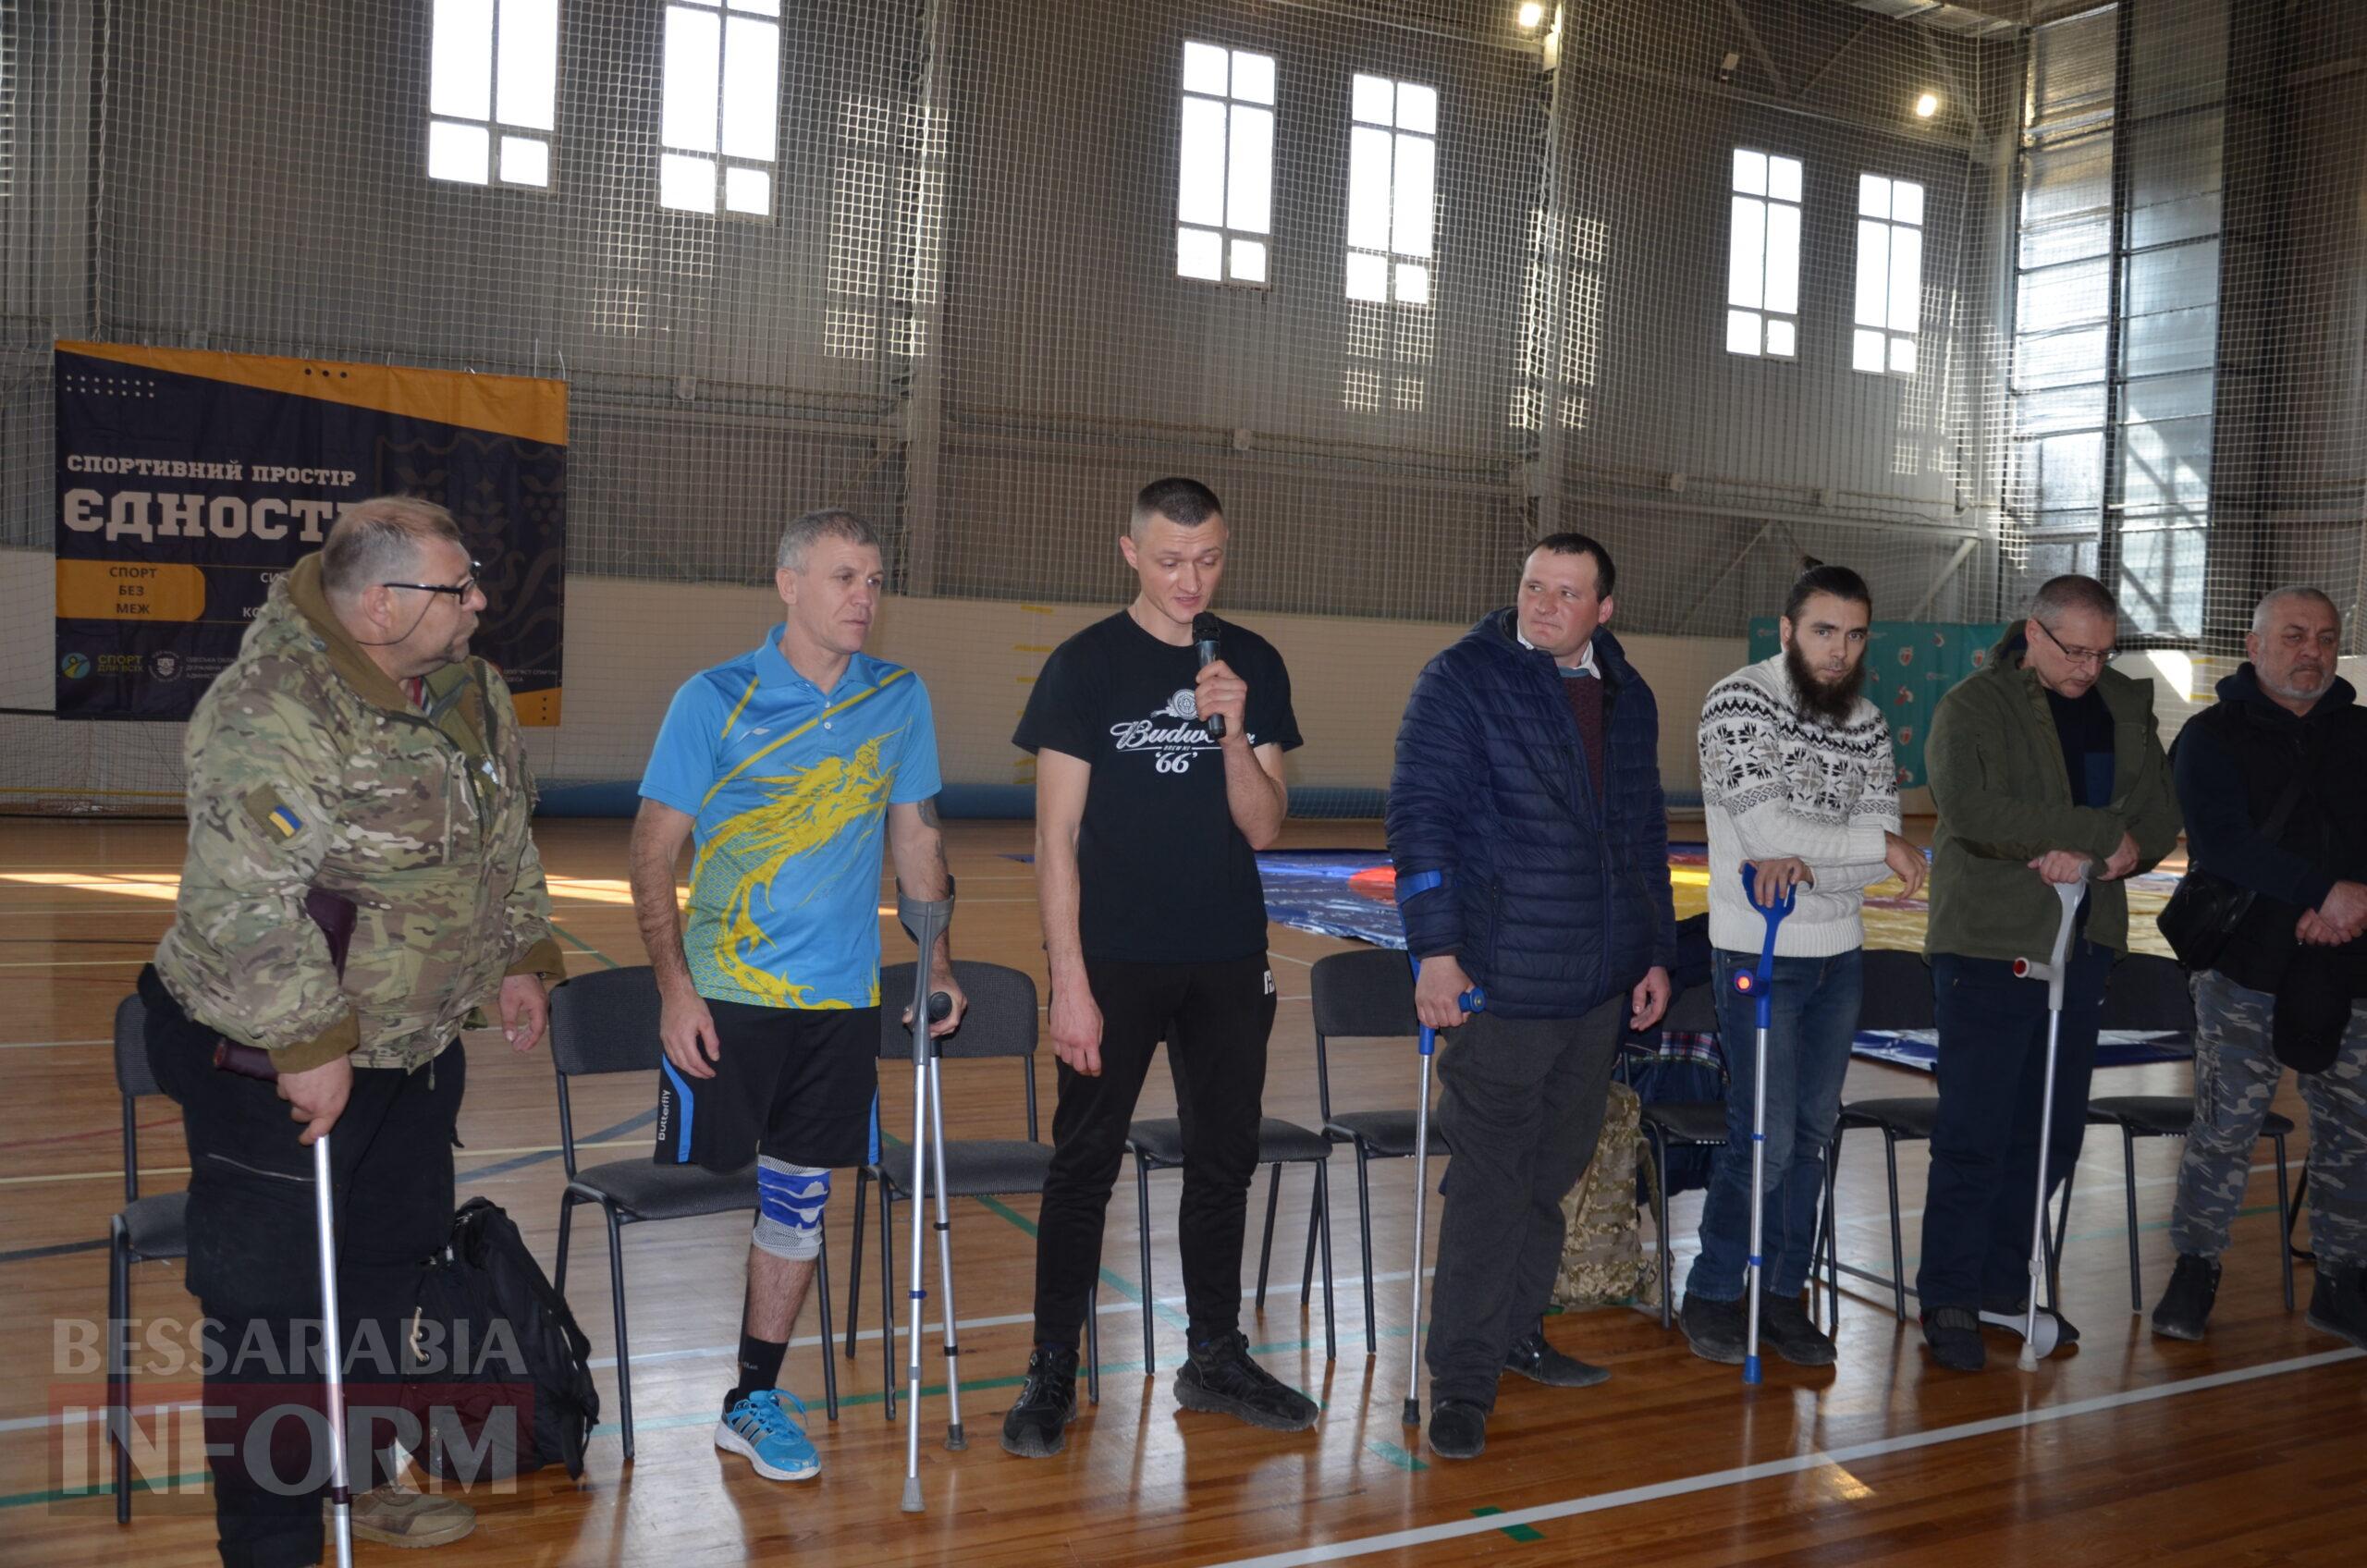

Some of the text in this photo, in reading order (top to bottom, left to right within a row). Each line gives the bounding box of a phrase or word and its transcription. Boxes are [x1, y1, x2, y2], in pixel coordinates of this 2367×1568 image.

[67, 454, 357, 486] СПОРТИВНИЙ ПРОСТІР
[109, 566, 157, 579] СПОРТ
[118, 585, 144, 596] БЕЗ
[116, 603, 150, 615] МЕЖ
[97, 654, 143, 664] СПОРТ
[657, 1089, 671, 1141] Butterfly
